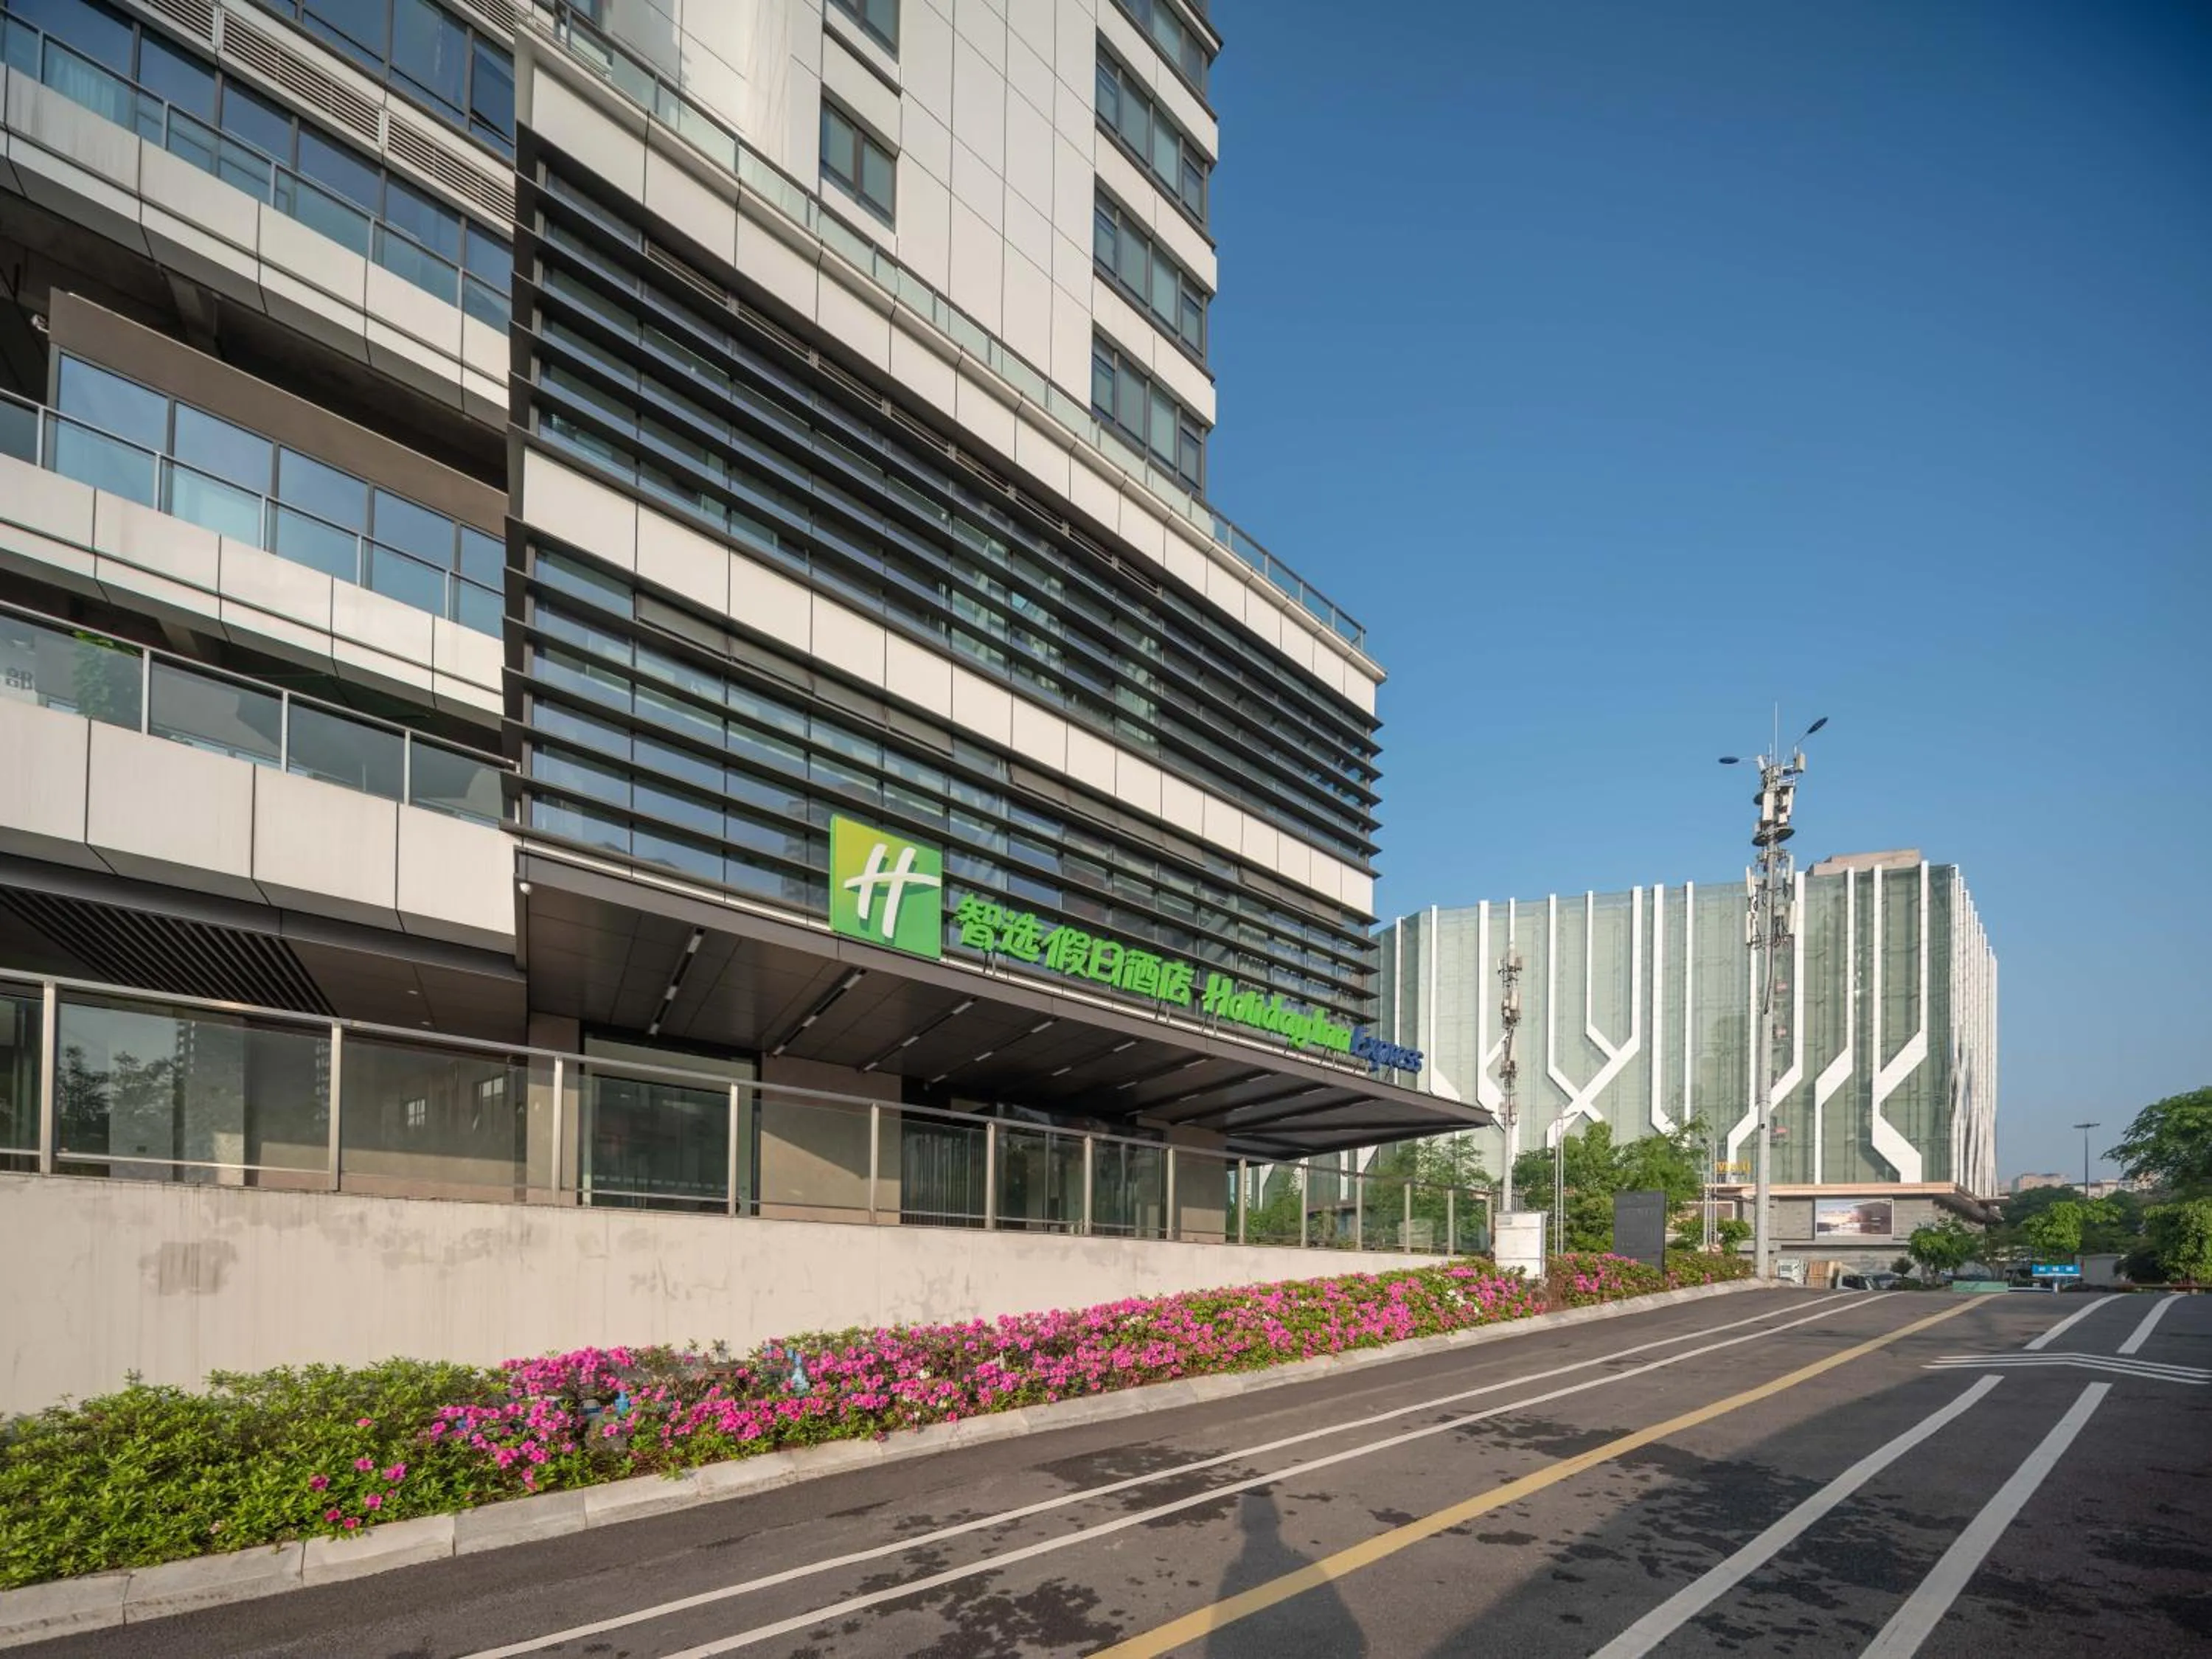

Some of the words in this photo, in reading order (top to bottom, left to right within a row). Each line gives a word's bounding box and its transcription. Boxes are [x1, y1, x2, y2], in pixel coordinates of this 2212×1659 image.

[844, 844, 942, 938] H
[954, 893, 1194, 1006] 智选假日酒店
[1202, 973, 1308, 1048] Holiday
